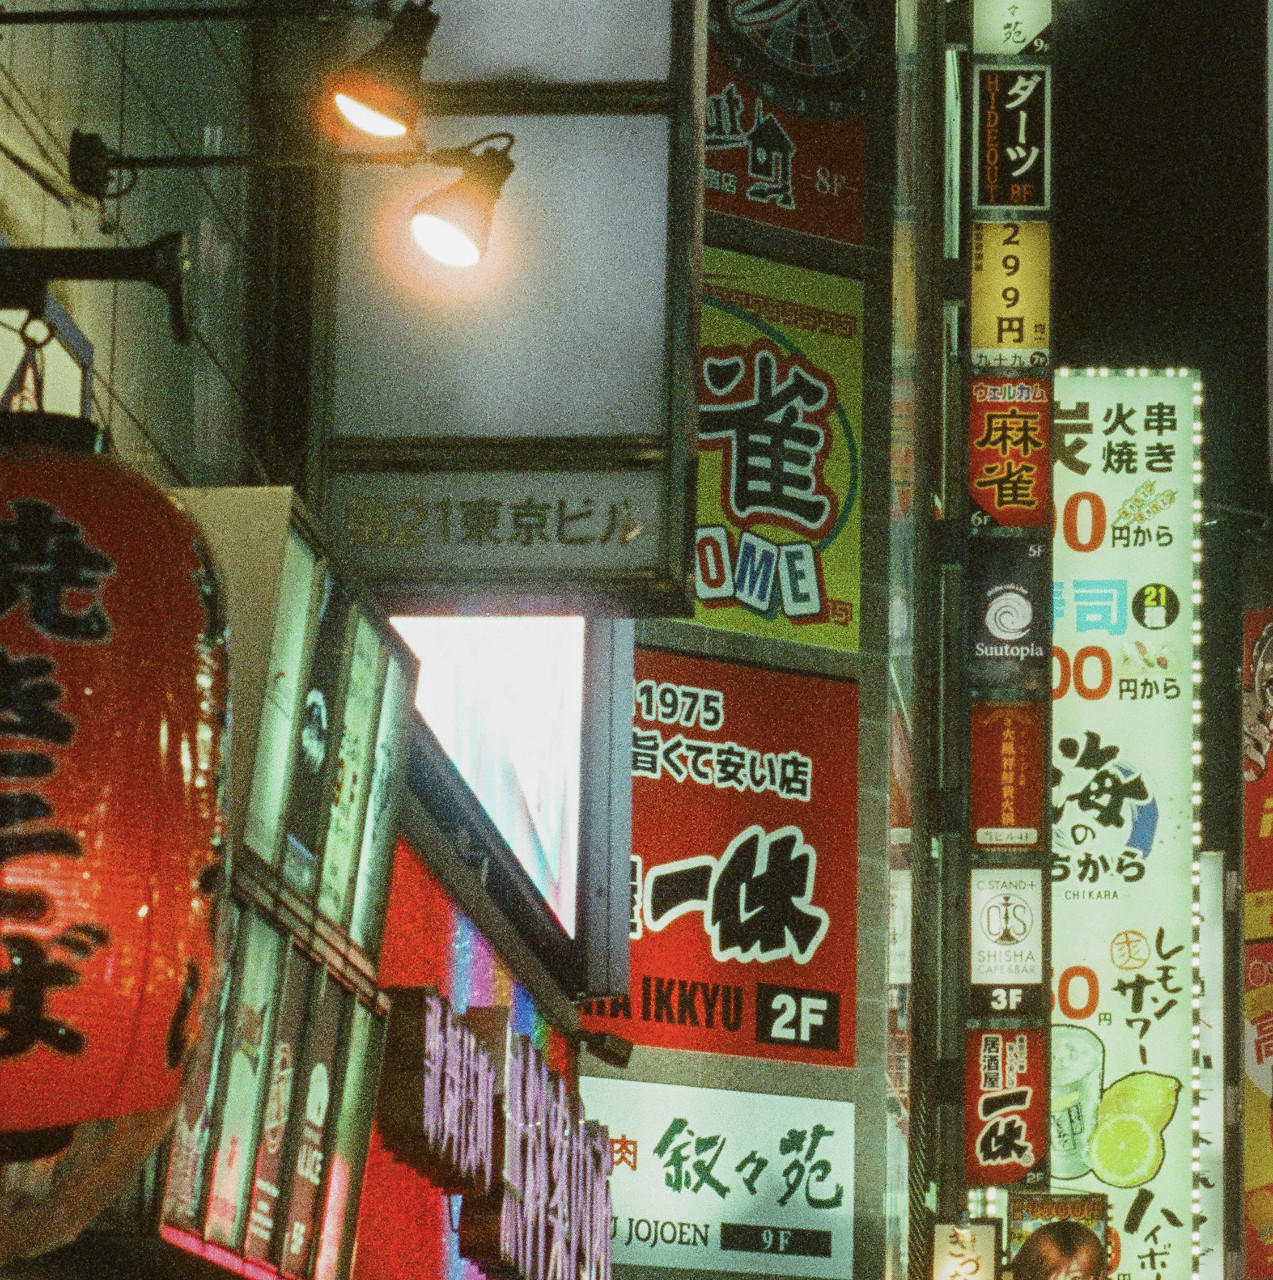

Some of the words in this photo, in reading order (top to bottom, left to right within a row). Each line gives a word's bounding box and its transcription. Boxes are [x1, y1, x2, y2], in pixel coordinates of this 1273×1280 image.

[987, 73, 999, 204] HIDEOUT
[1005, 74, 1043, 177] ダーツ
[997, 222, 1025, 344] 299円
[973, 383, 1047, 403] ウェルカム
[974, 407, 1045, 510] 麻雀
[1053, 490, 1107, 553] 0
[975, 642, 1044, 659] Suutopia
[637, 679, 724, 730] 1975
[632, 730, 811, 801] 旨くて安い店
[1065, 890, 1119, 901] CHIKARA
[978, 950, 1036, 963] SHISHA
[1150, 926, 1185, 1020] レモン
[641, 975, 744, 1032] IKKYU
[770, 993, 829, 1042] 2F
[991, 988, 1023, 1011] 3F
[982, 1035, 1003, 1090] 居酒屋
[1026, 1171, 1044, 1184] 2F
[624, 1218, 710, 1248] JOJOEN
[760, 1229, 793, 1253] 9F
